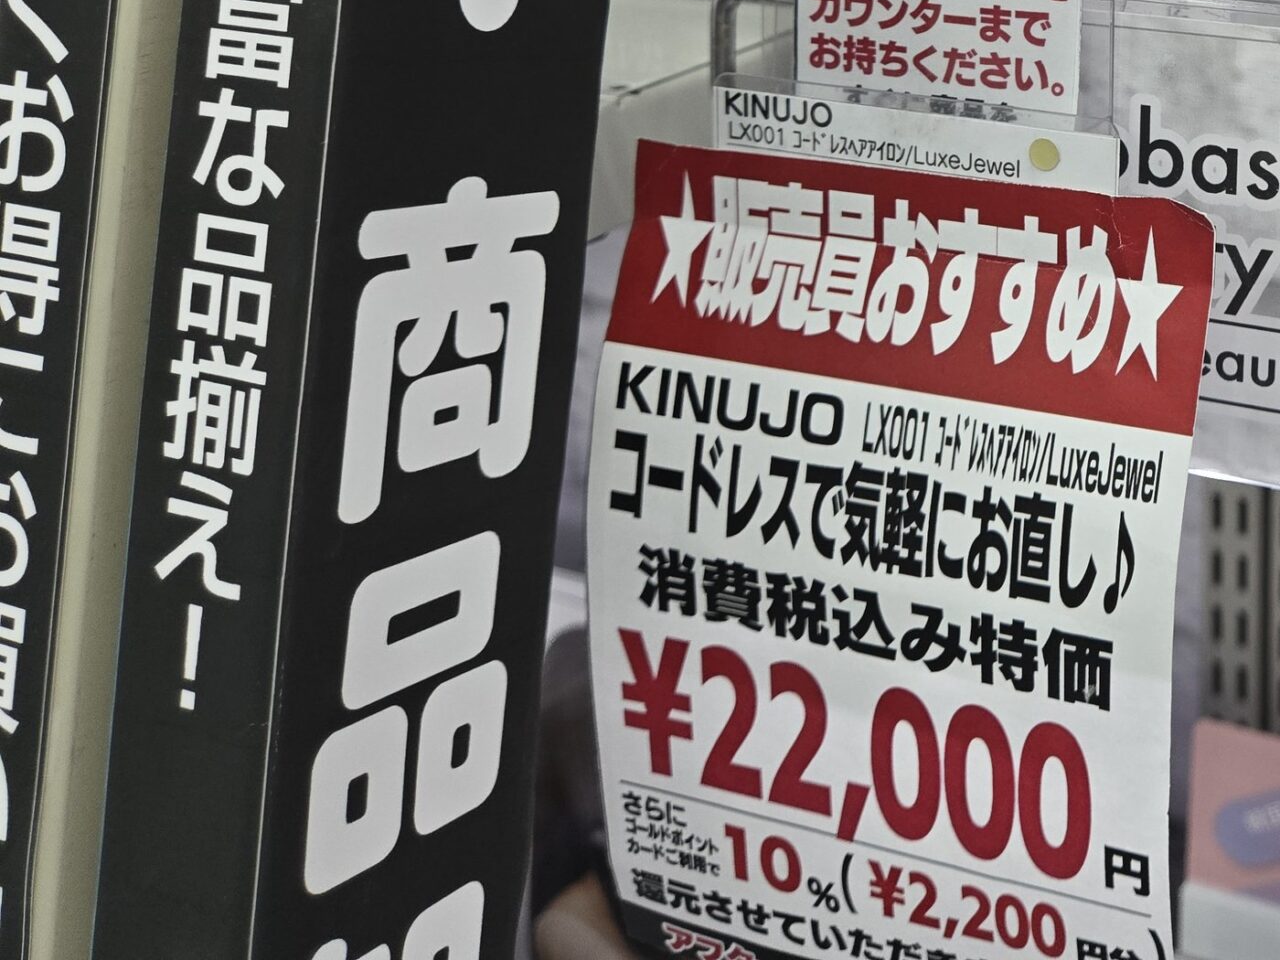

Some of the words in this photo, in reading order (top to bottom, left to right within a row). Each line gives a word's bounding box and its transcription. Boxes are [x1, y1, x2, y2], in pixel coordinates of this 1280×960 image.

[809, 32, 1064, 98] お持ちください。
[724, 90, 832, 128] KINUJO
[728, 121, 784, 146] LX001
[615, 362, 845, 446] KINUJO
[861, 401, 930, 463] LX001
[637, 543, 1114, 712] 消費税込み特価
[622, 790, 688, 828] さらに
